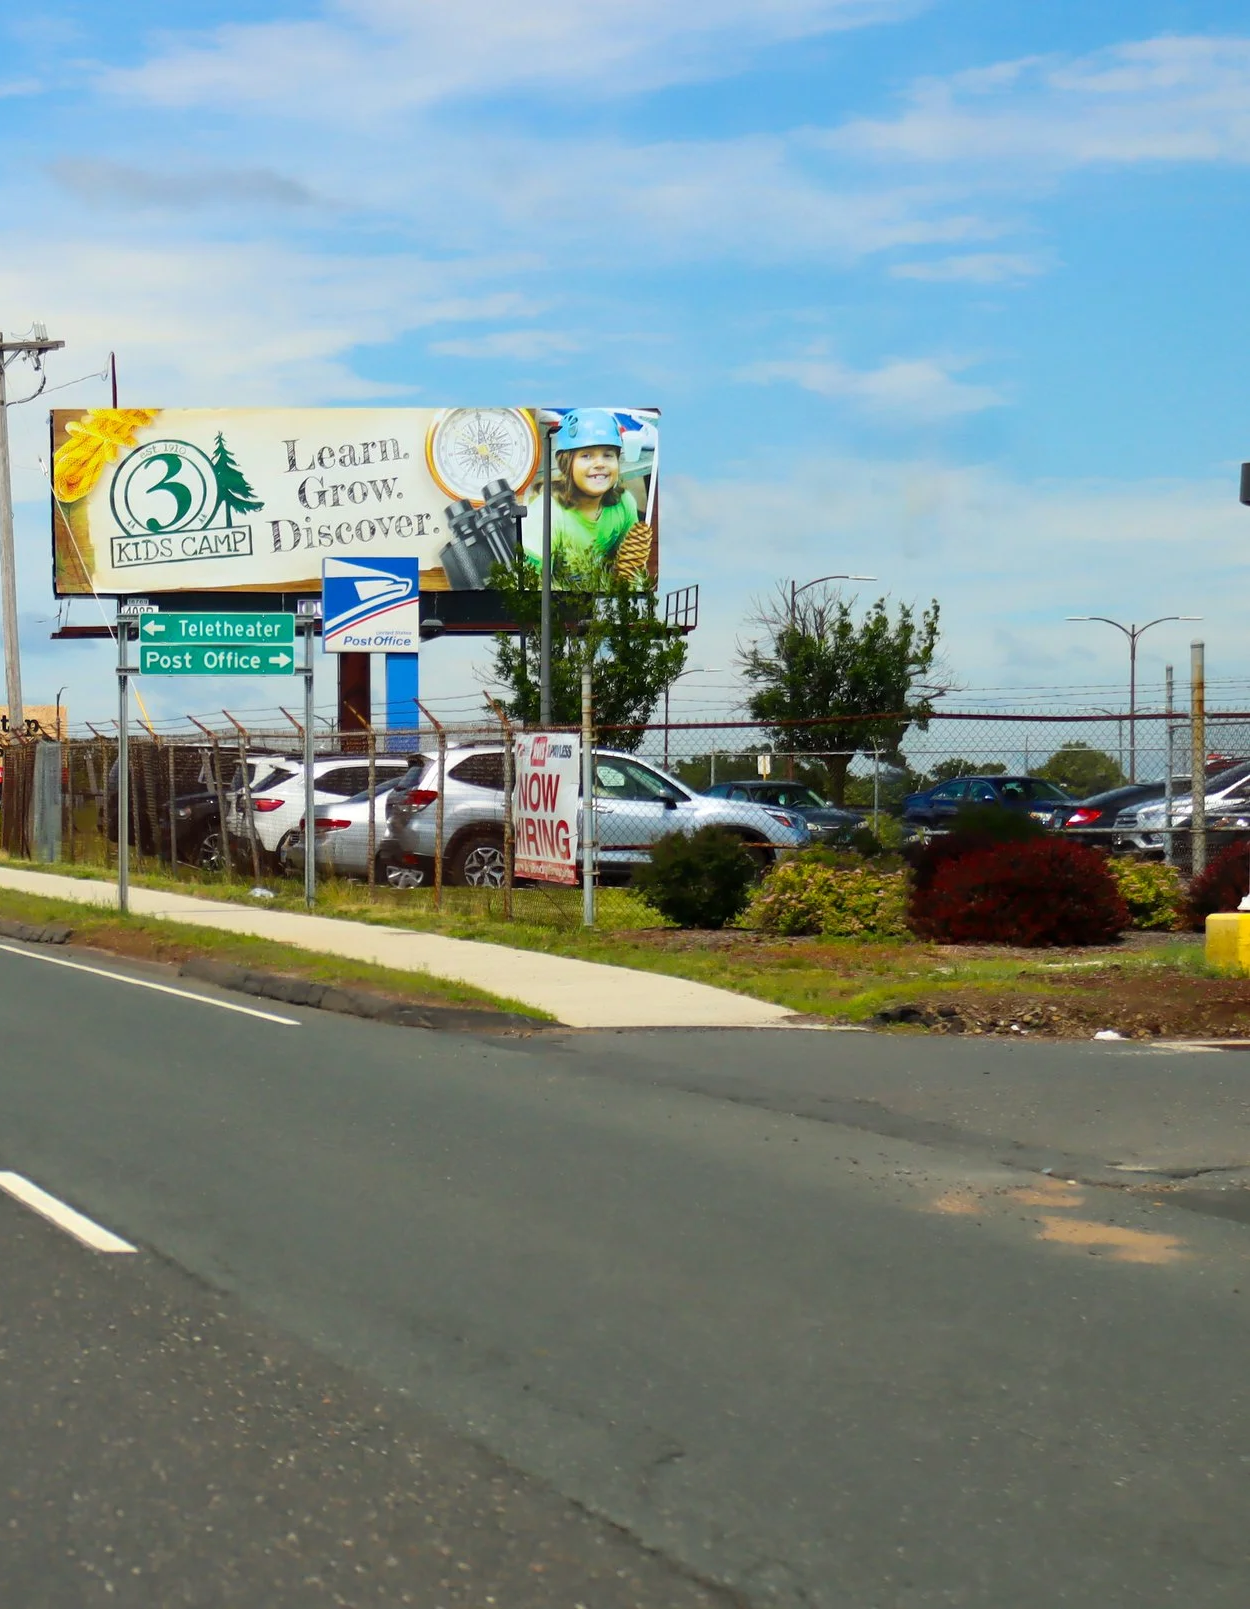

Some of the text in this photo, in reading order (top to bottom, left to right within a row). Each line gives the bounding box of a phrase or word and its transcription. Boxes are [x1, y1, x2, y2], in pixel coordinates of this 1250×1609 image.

[163, 443, 187, 455] 1910
[281, 438, 410, 473] Learn.
[144, 453, 192, 532] 3
[298, 475, 403, 510] Grow.
[117, 531, 246, 563] KIDS CAMP
[265, 512, 440, 553] Discover.
[179, 620, 281, 637] Teletheater
[343, 636, 411, 646] Post Office
[146, 652, 261, 668] Post Office
[518, 772, 560, 813] NOW
[515, 818, 571, 860] HIRING
